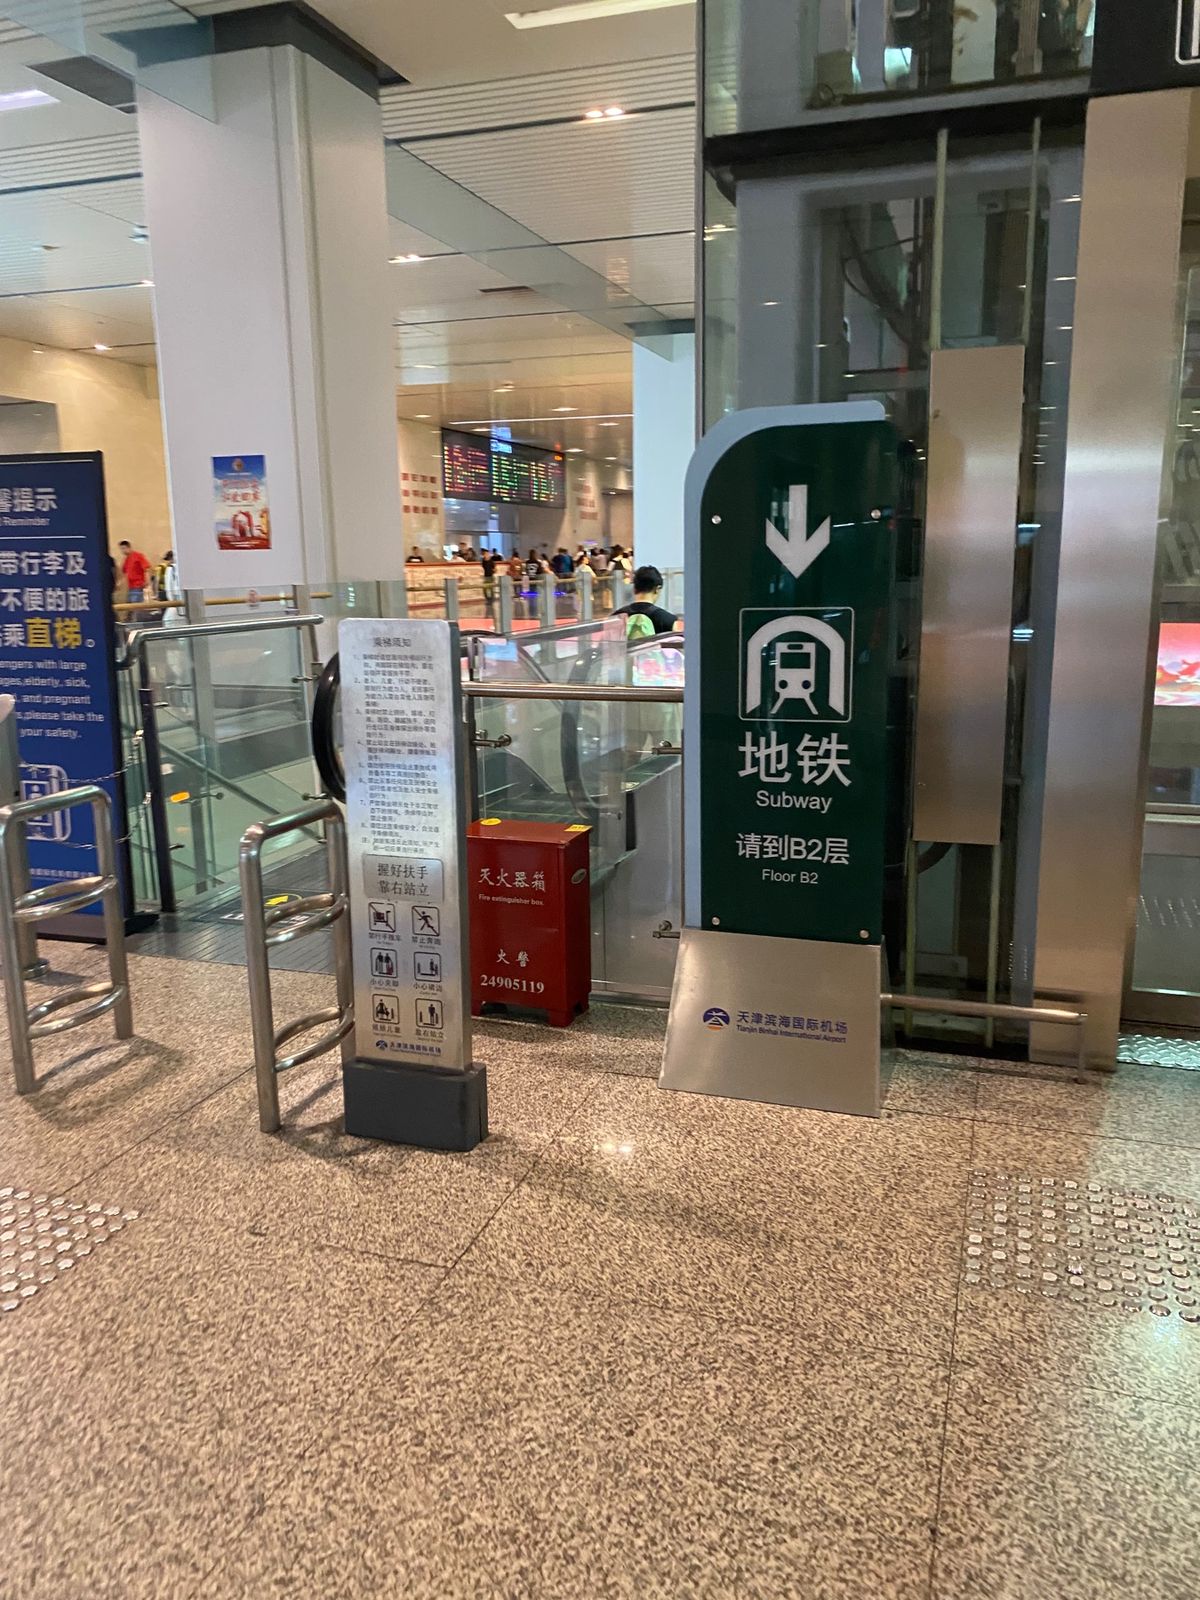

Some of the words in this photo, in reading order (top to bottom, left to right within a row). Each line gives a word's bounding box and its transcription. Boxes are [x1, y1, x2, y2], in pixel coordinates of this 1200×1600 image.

[0, 551, 87, 575] 带行李及
[1, 588, 90, 612] 不便的旅
[36, 660, 58, 670] with
[60, 660, 87, 672] large
[65, 677, 91, 688] sick,
[22, 694, 42, 703] and
[43, 695, 91, 705] pregnant
[62, 711, 85, 721] take
[87, 712, 104, 722] the
[20, 728, 43, 738] your
[45, 728, 82, 739] safety.
[738, 731, 852, 787] 地铁
[756, 790, 832, 814] Subway
[736, 833, 850, 865] 请到B2层
[377, 863, 429, 879] 握好扶手
[478, 868, 545, 892] 灭火器箱
[762, 869, 796, 882] Floor
[800, 872, 818, 884] B2
[377, 880, 430, 897] 靠右站立
[492, 896, 530, 905] extinguisher
[497, 949, 530, 968] 火警
[480, 974, 545, 993] 24905119
[737, 1011, 848, 1034] 天津滨海国际机场
[737, 1025, 758, 1034] Tianjin
[759, 1027, 778, 1036] Binhai
[780, 1030, 822, 1040] International
[823, 1034, 846, 1043] Airport
